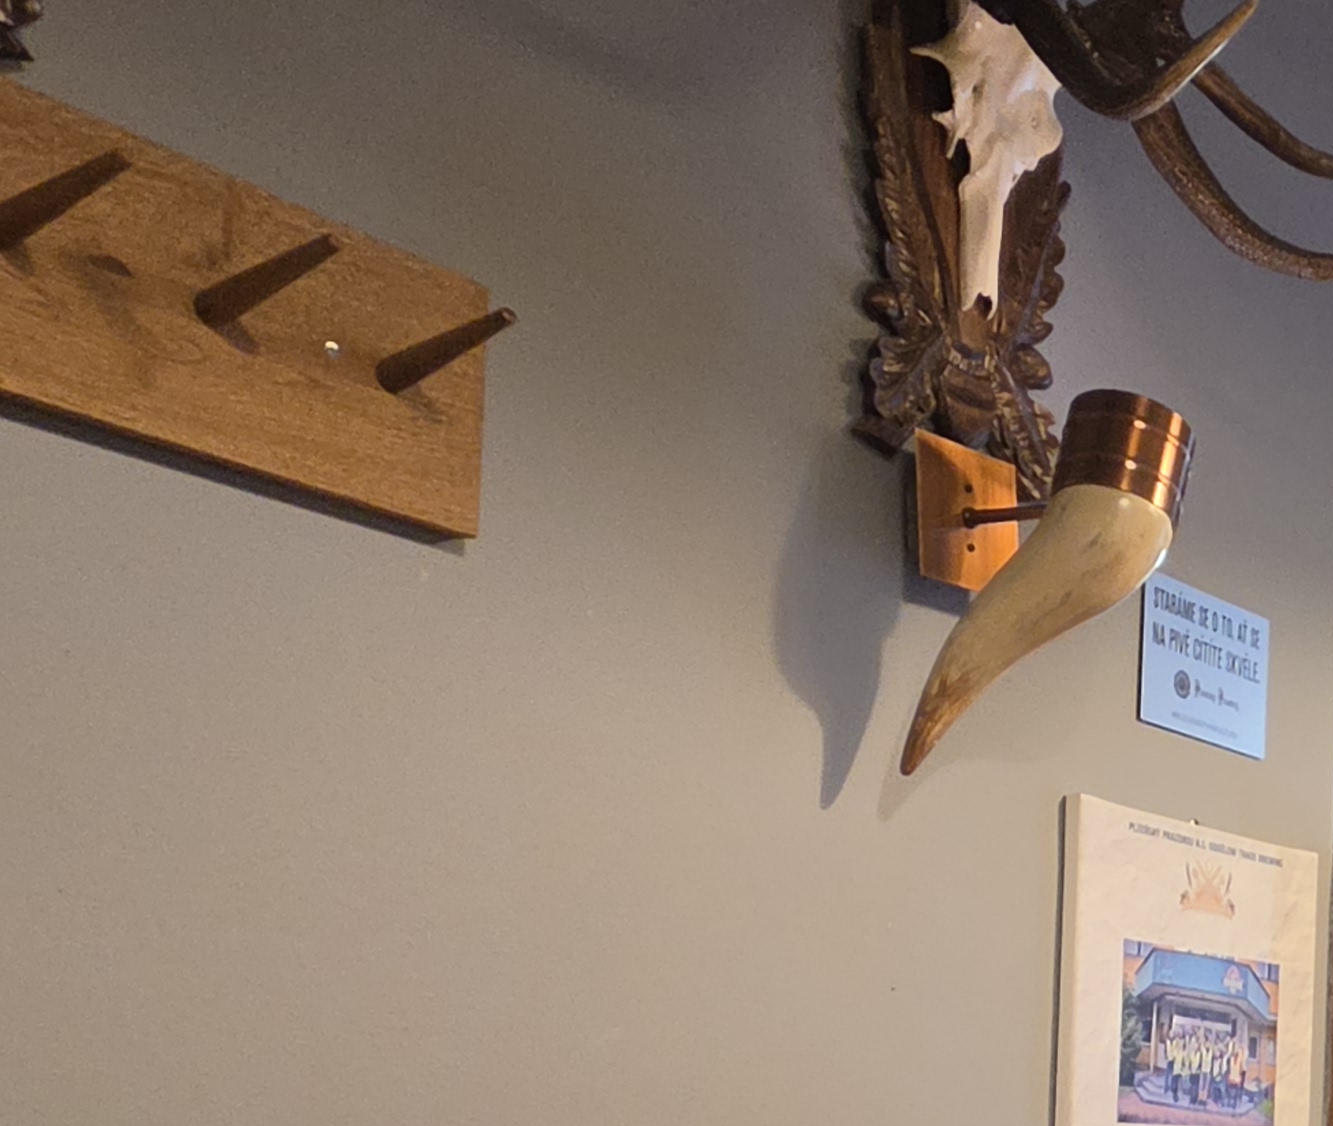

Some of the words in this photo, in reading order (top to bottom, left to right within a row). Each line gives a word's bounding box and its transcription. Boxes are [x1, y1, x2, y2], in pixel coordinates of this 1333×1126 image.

[1152, 621, 1166, 648] NA
[1168, 628, 1190, 658] PIVĚ
[1153, 586, 1196, 624] STARÁME
[1199, 605, 1209, 630] SE
[1212, 611, 1219, 633] O
[1251, 627, 1260, 651] SE
